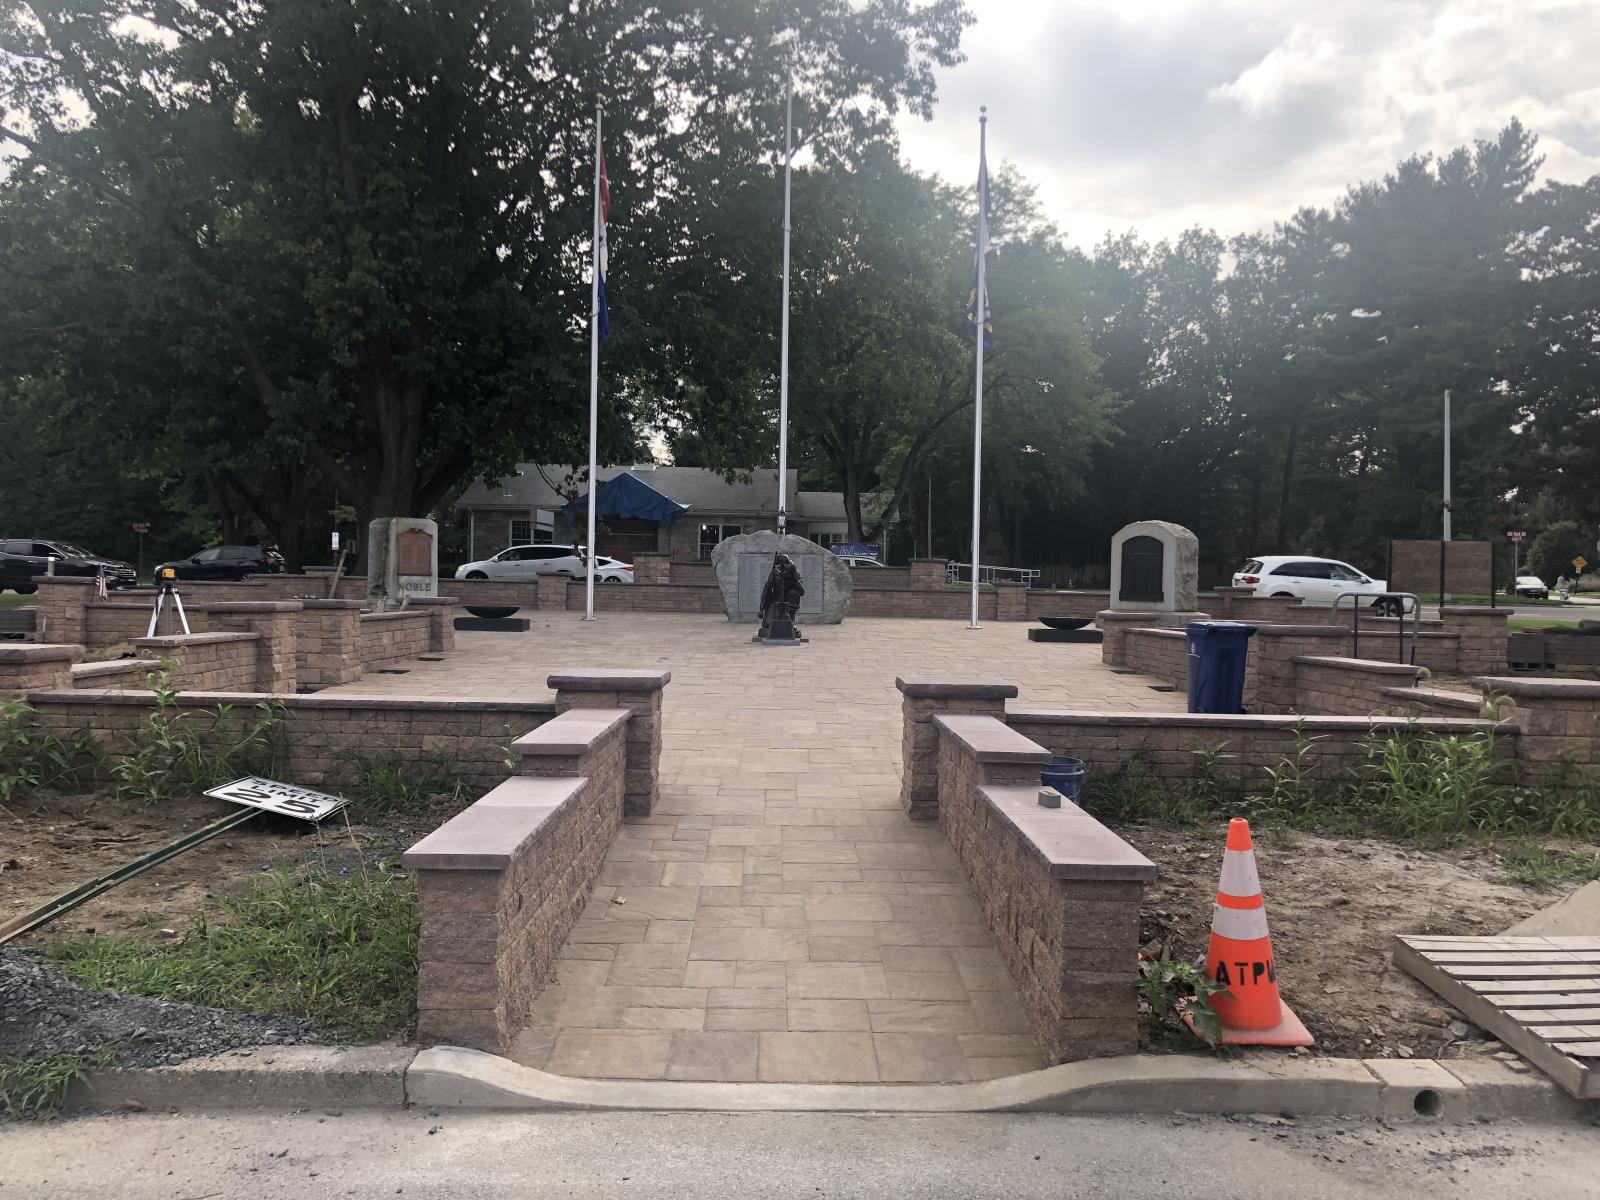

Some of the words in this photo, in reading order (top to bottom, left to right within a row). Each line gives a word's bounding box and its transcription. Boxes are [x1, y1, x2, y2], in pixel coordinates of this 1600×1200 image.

[398, 582, 432, 592] NOBLE
[222, 788, 320, 813] 25
[251, 785, 327, 803] LIMIT
[252, 780, 338, 802] SPEED
